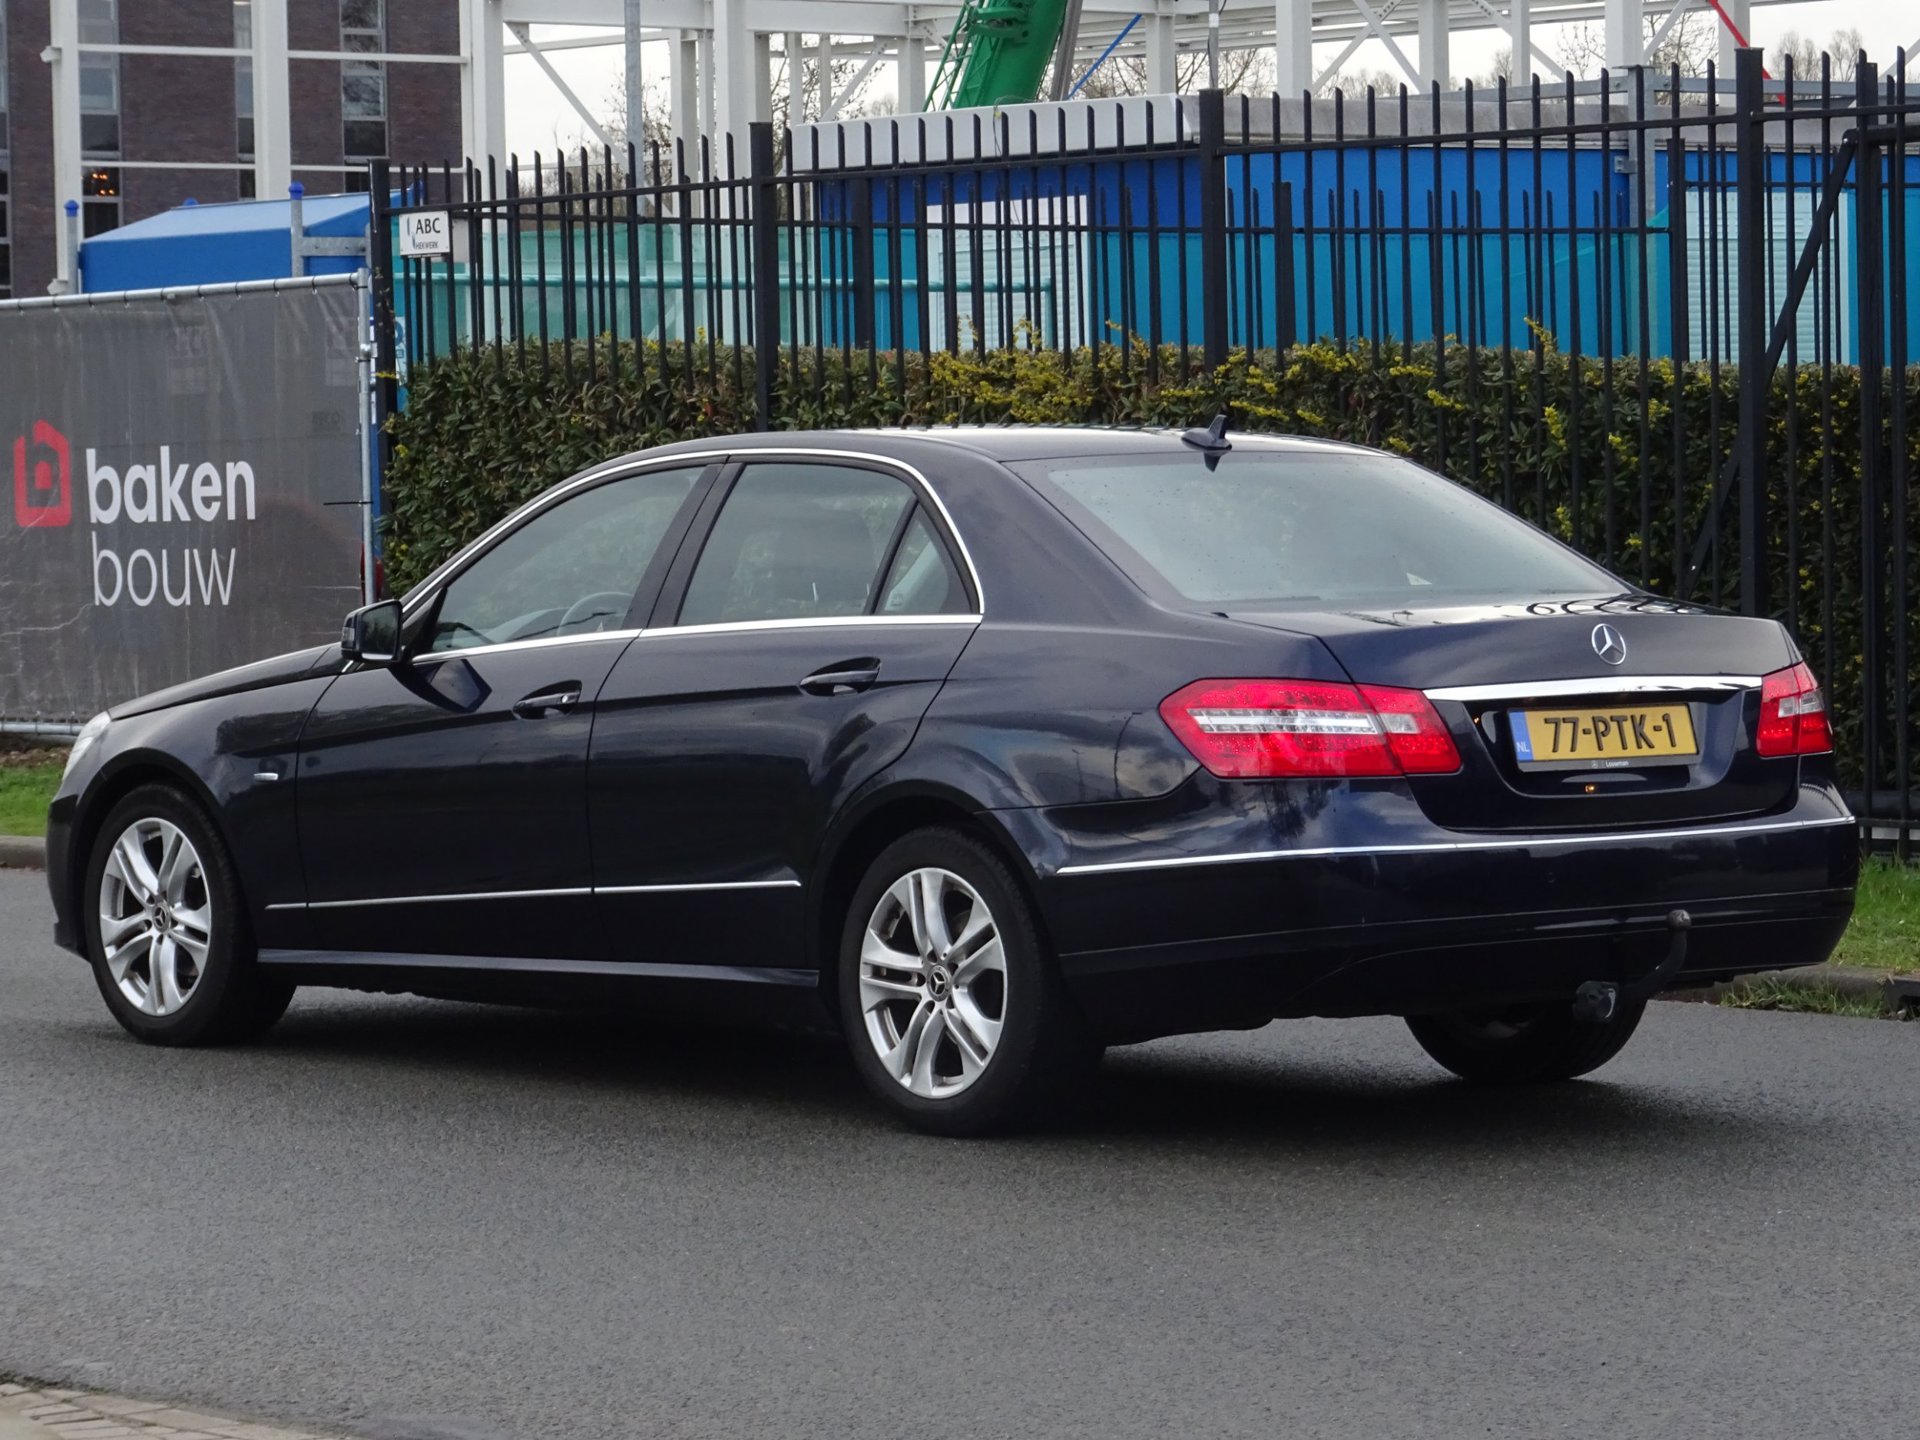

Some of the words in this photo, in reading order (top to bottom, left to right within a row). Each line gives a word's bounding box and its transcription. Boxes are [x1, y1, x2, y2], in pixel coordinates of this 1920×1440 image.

[415, 217, 441, 235] ABC
[86, 445, 256, 524] baken
[91, 530, 236, 607] bouw
[1516, 741, 1530, 753] NL
[1544, 713, 1677, 753] 77-PTK-1
